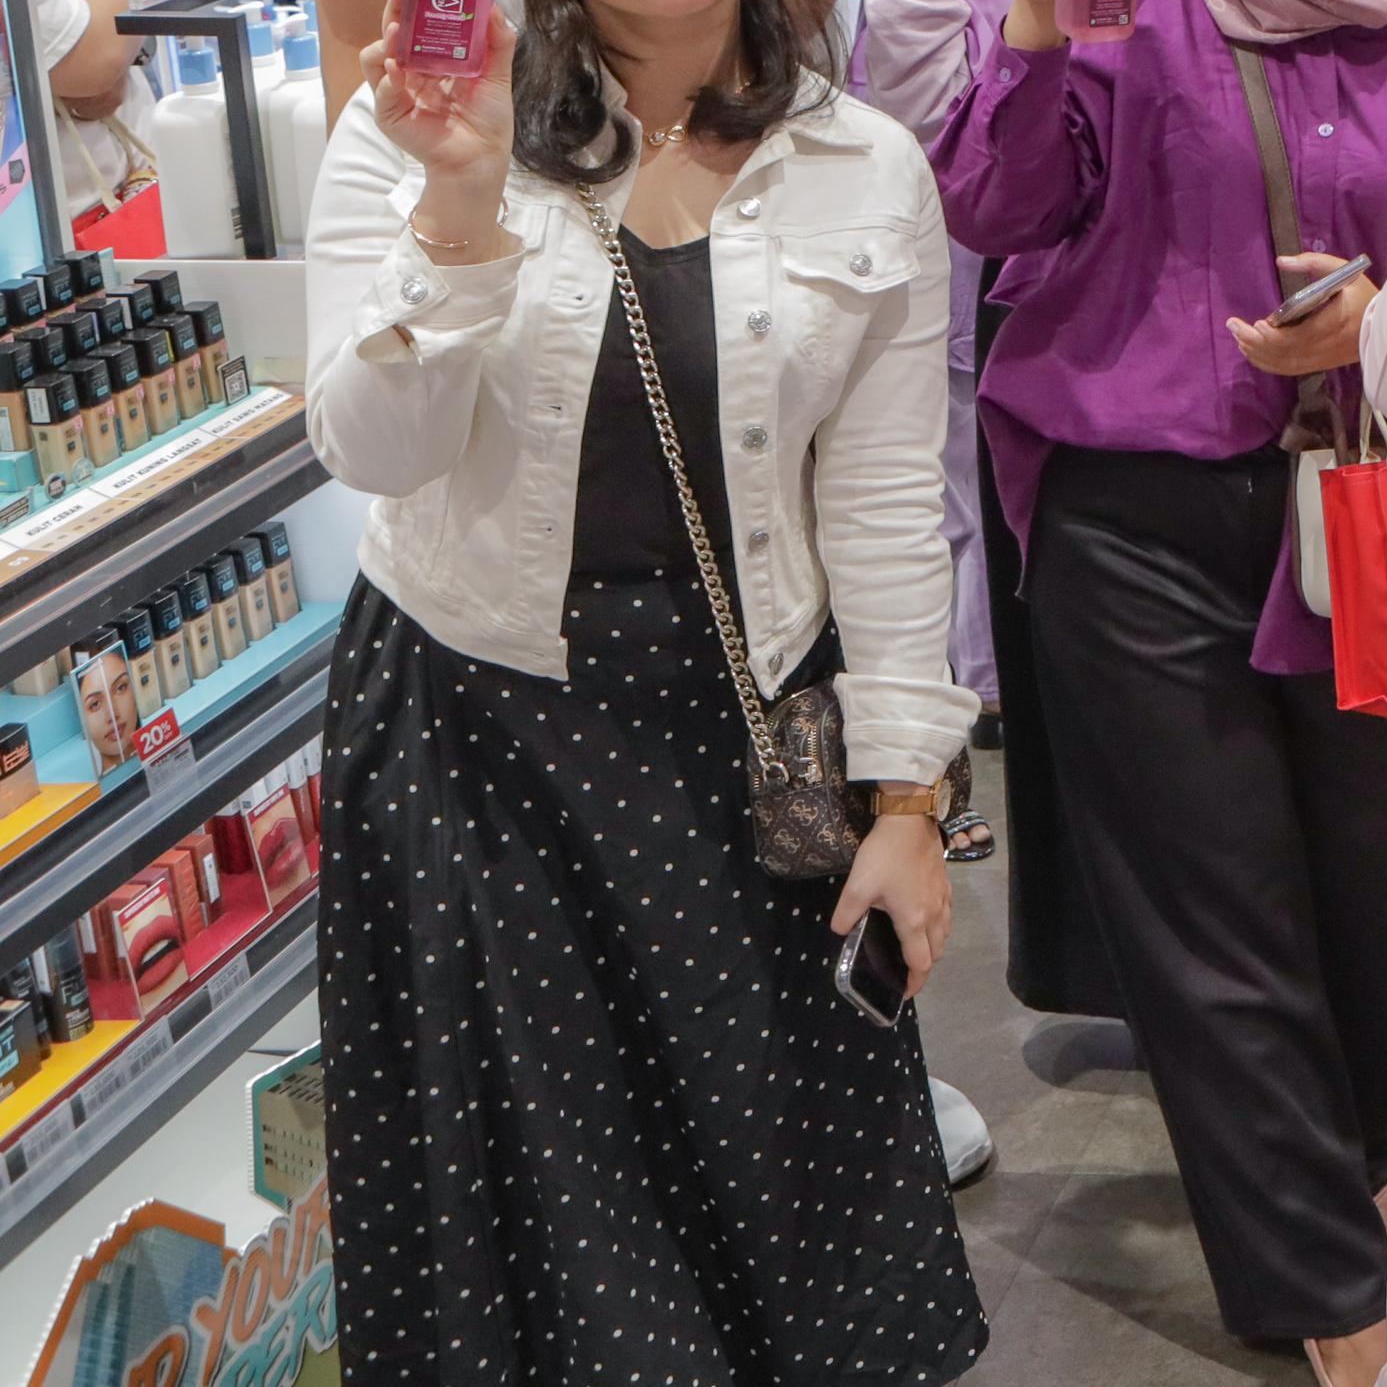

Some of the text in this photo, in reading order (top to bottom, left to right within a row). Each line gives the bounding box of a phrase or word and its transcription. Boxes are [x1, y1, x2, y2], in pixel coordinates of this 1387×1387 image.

[112, 438, 203, 489] KULIT KUNING LANGSAT
[25, 504, 83, 537] KULIT CERAH
[138, 719, 172, 756] 20%
